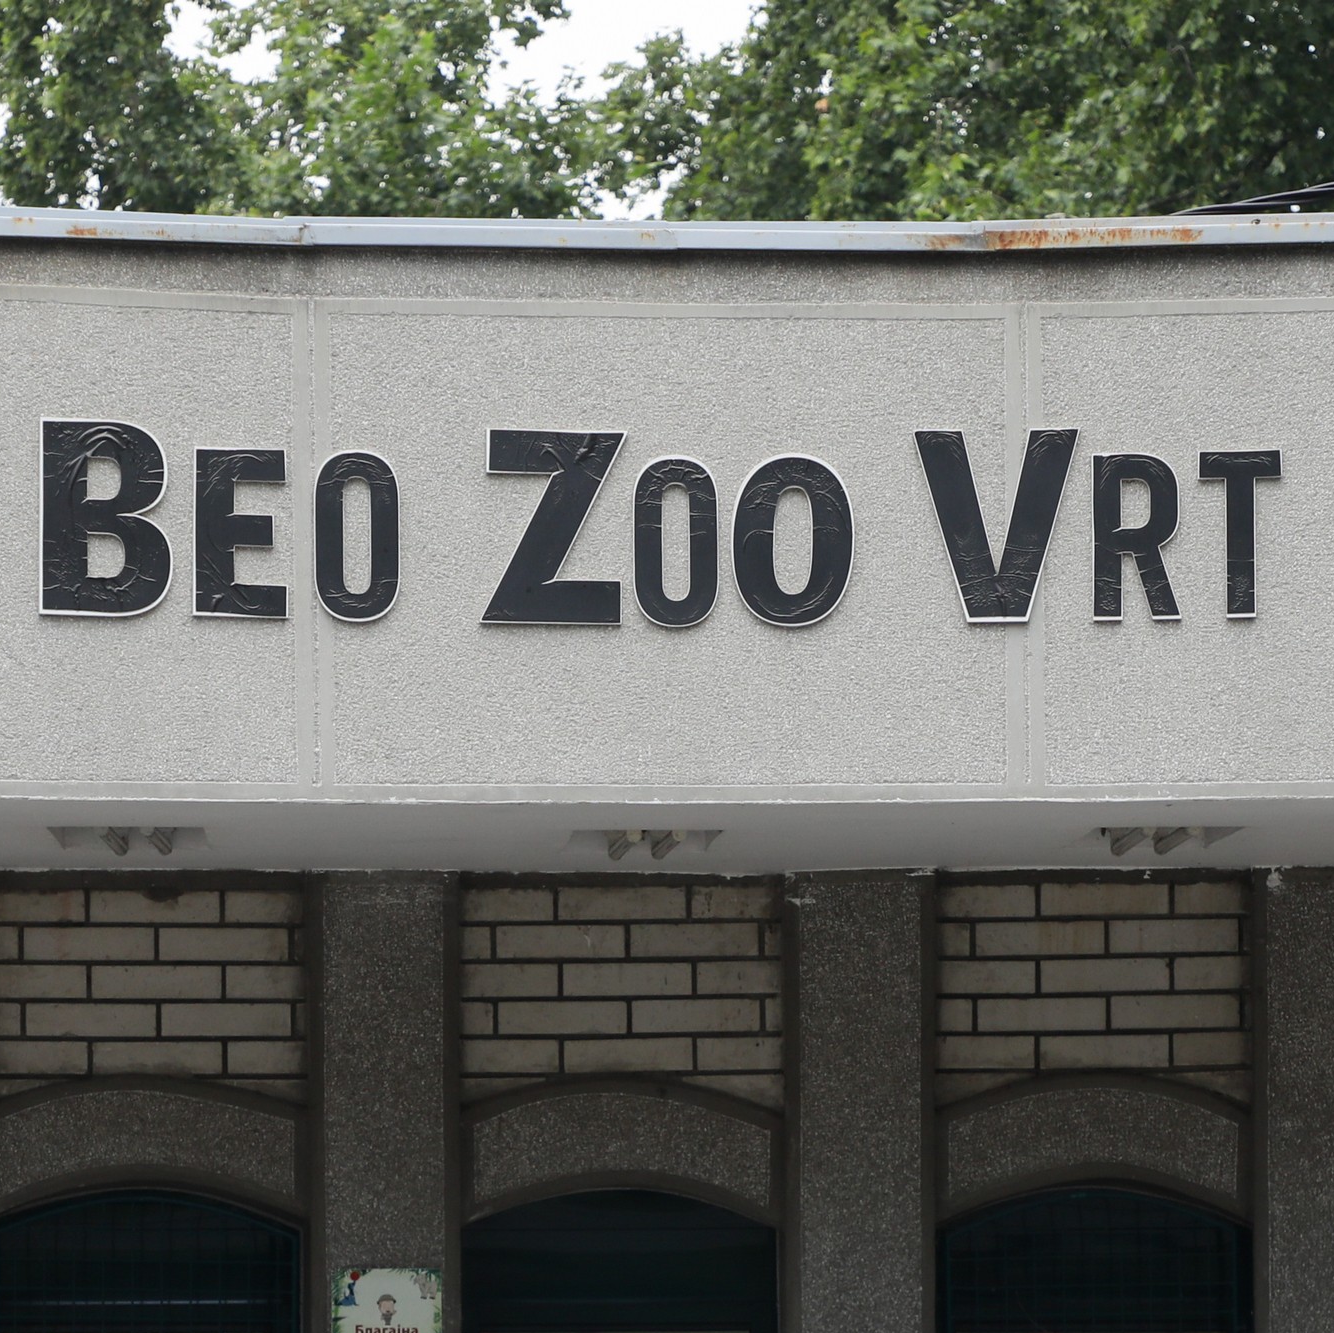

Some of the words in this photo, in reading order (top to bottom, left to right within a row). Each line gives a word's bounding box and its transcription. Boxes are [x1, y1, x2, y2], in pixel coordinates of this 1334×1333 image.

[38, 417, 401, 622] BEO
[479, 426, 856, 627] ZOO
[912, 427, 1283, 623] VRT
